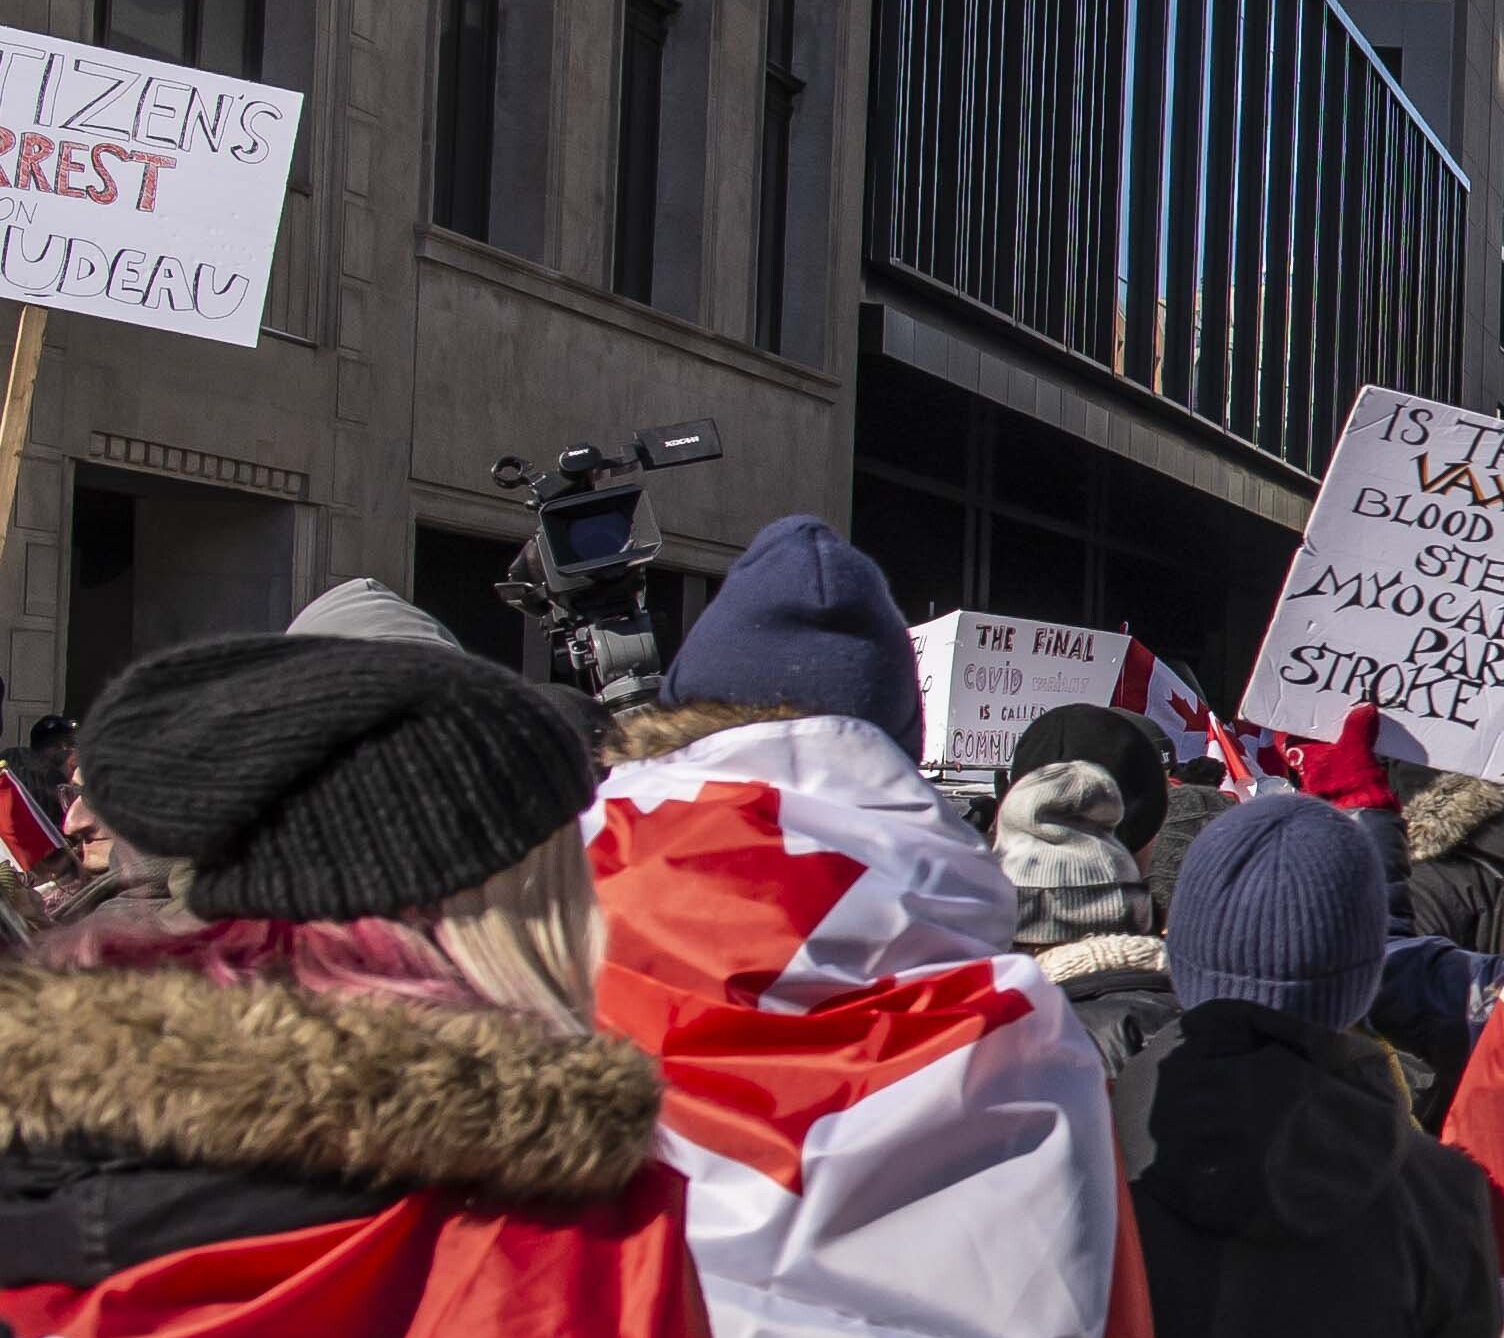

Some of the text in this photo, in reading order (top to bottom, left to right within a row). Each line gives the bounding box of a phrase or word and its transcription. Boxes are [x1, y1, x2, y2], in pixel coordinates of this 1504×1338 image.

[1378, 403, 1434, 446] IS
[1351, 486, 1496, 544] BLOOD
[974, 623, 1017, 653] THE
[1280, 644, 1485, 731] STROKE
[978, 705, 991, 721] IS
